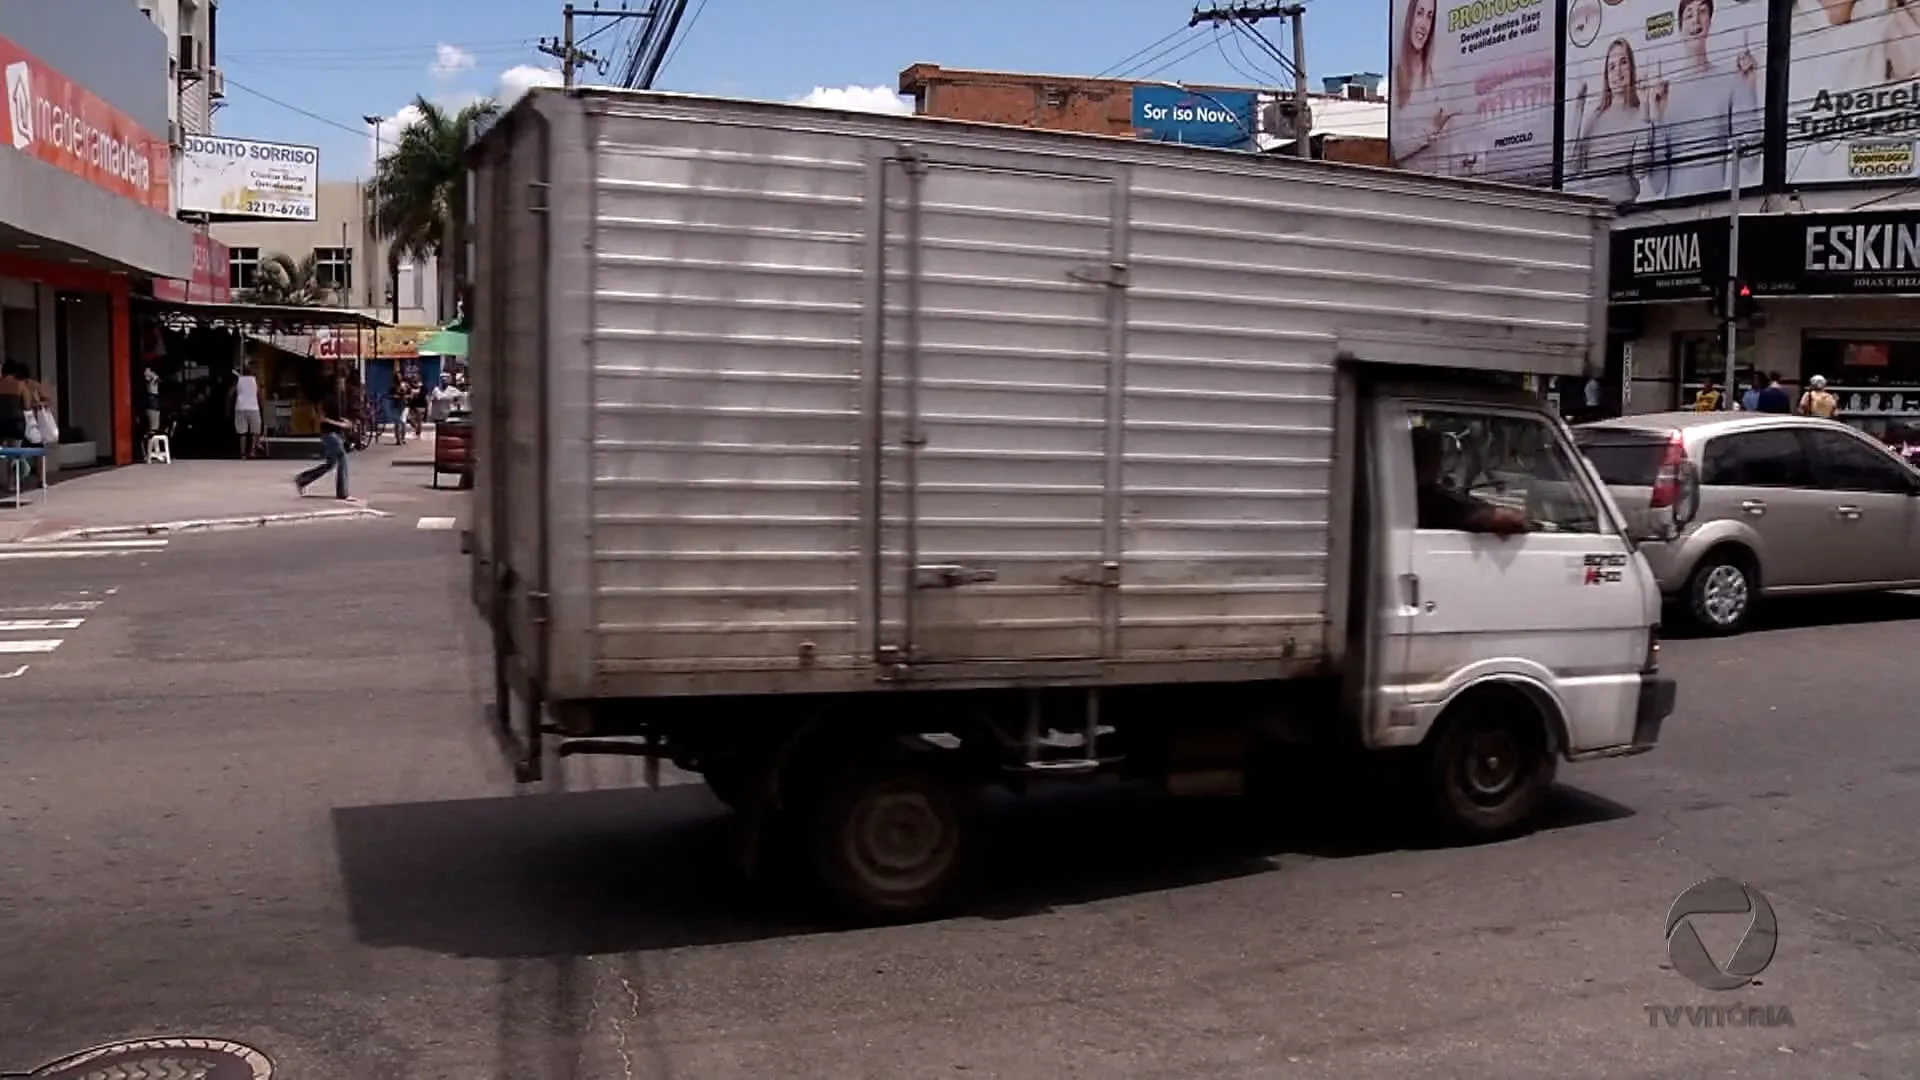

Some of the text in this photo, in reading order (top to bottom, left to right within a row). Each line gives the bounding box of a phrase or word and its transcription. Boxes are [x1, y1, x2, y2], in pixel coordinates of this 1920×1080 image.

[1460, 11, 1541, 43] Devolve dentes fixos
[1461, 45, 1467, 54] e
[1468, 33, 1506, 53] qualidade
[1508, 29, 1518, 40] de
[36, 96, 149, 192] madeiramadeira
[1494, 132, 1533, 148] PROTOCOLO
[249, 145, 315, 164] SORRISO
[1633, 232, 1701, 273] ESKINA
